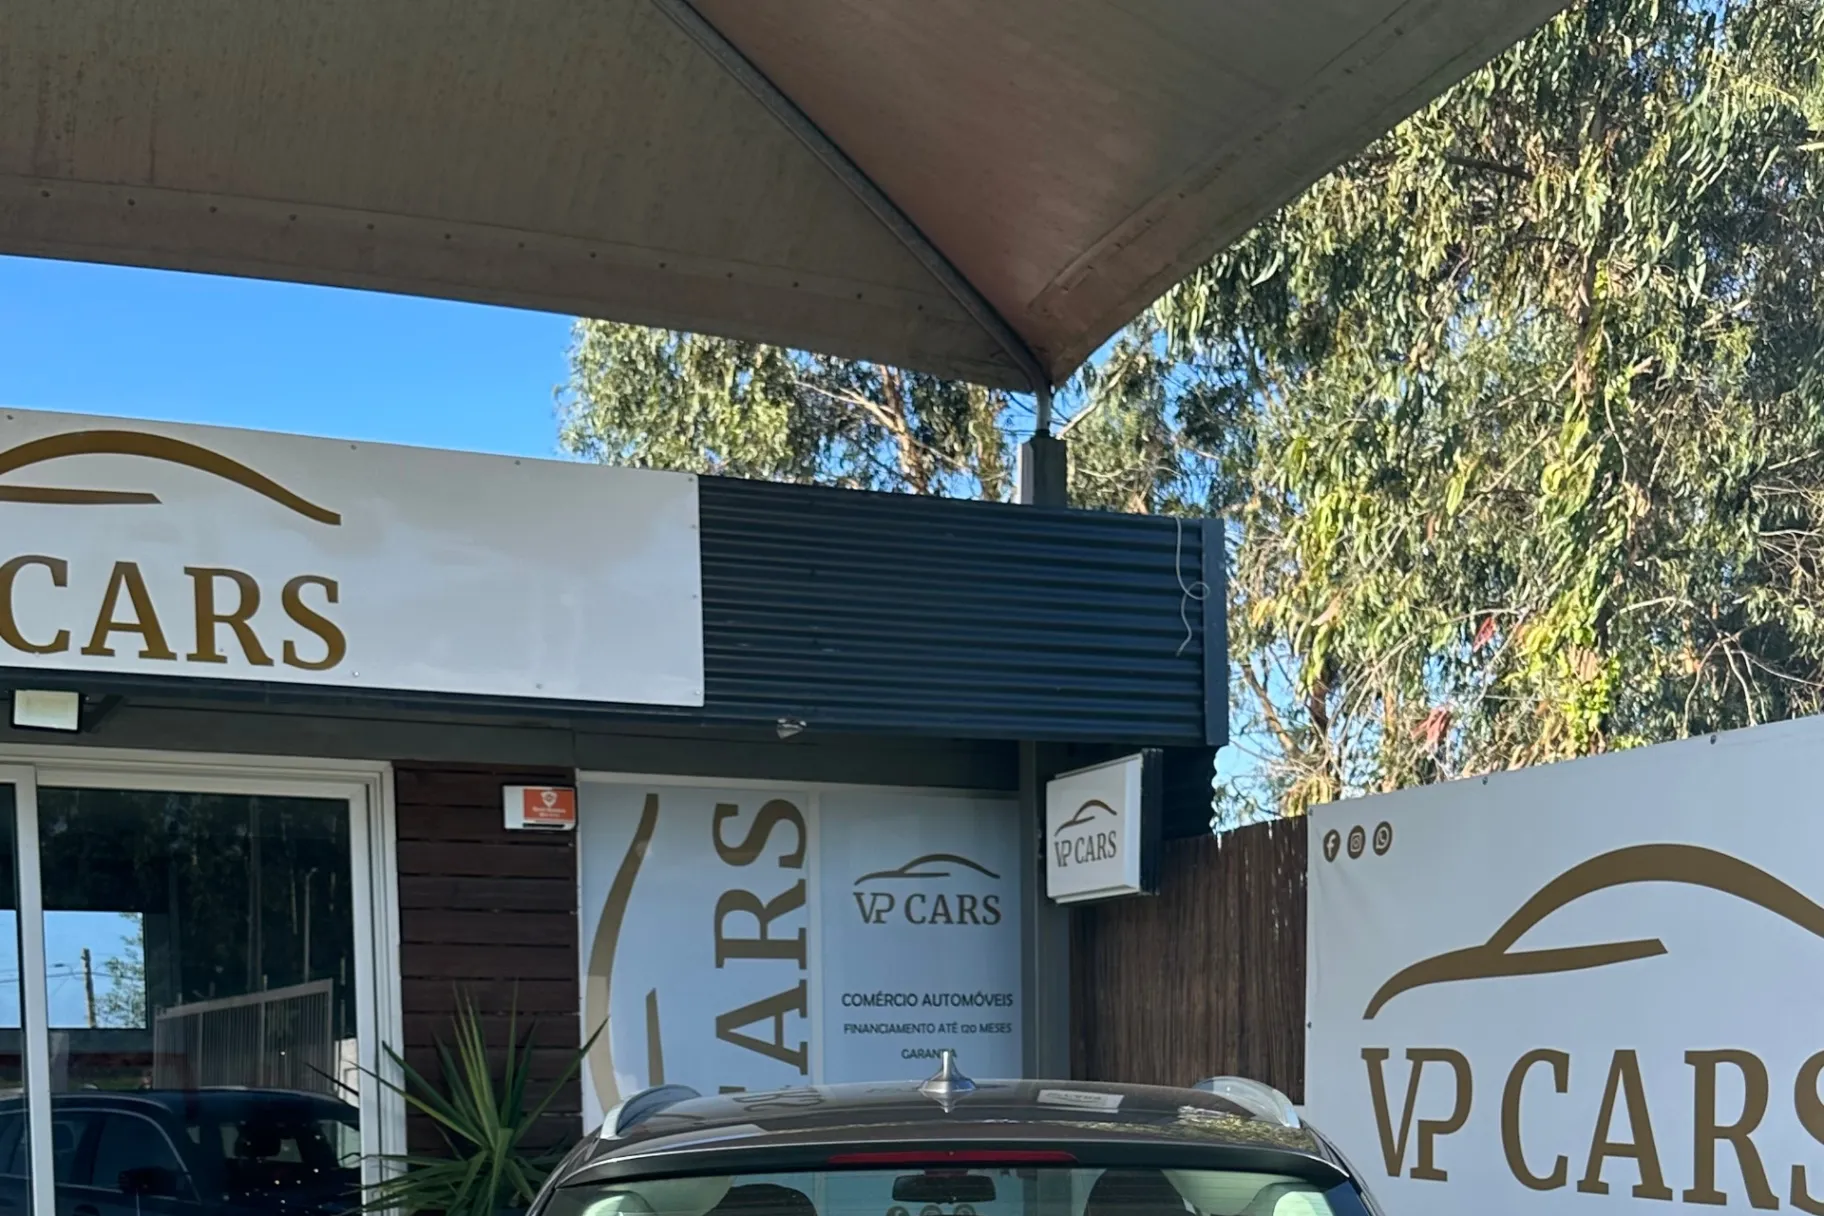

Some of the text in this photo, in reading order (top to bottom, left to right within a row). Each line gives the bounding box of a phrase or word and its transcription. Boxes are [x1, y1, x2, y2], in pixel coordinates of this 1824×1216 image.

[0, 554, 347, 671] CARS
[1054, 830, 1117, 868] VP CARS
[853, 892, 1002, 926] VP CARS
[712, 798, 808, 1095] ARS
[841, 991, 1013, 1008] COMÉRCIO AUTOMÓVEIS
[843, 1021, 1012, 1034] FINANCIAMENTO ATÉ 120 MESES
[900, 1048, 957, 1060] GARANTA
[1361, 1047, 1473, 1182] VP
